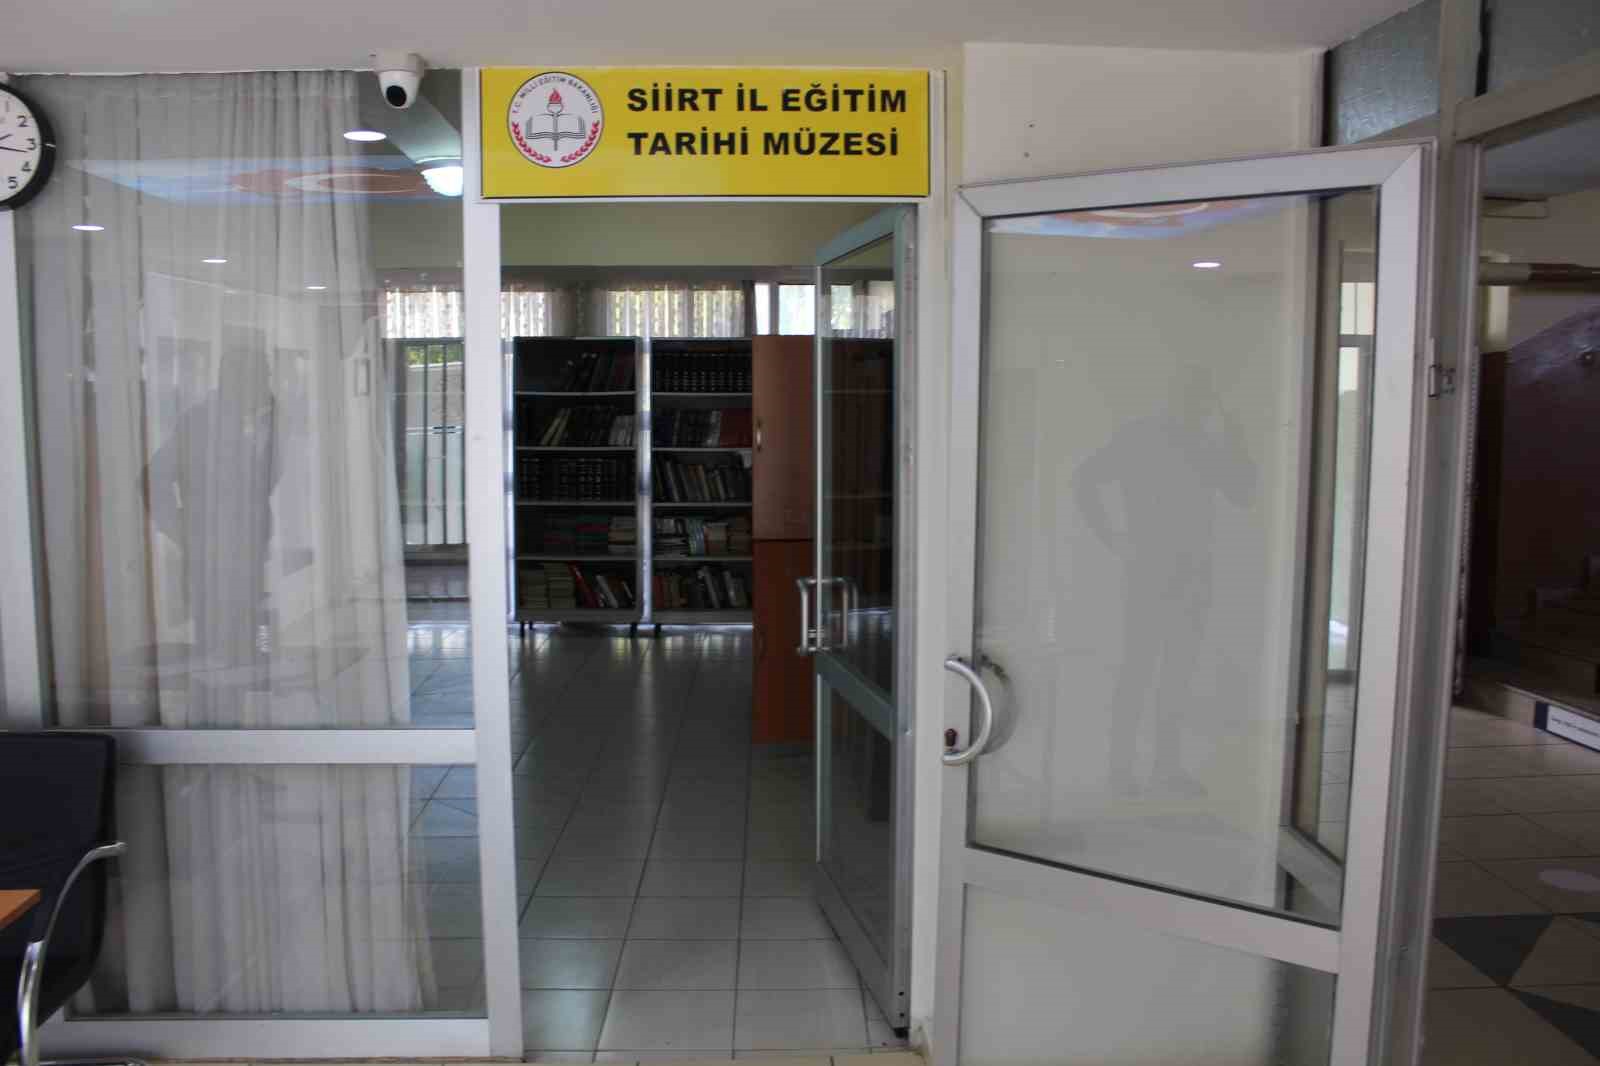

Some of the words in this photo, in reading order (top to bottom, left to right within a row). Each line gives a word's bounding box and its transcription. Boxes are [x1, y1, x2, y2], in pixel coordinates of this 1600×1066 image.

[627, 82, 723, 112] SİİRT
[736, 82, 768, 112] İL
[782, 83, 906, 112] EĞİTİM
[17, 115, 29, 128] 2
[26, 138, 37, 151] 3
[627, 126, 748, 155] TARİHİ
[763, 127, 897, 156] MÜZESİ
[21, 161, 32, 172] 4
[8, 176, 18, 190] 5
